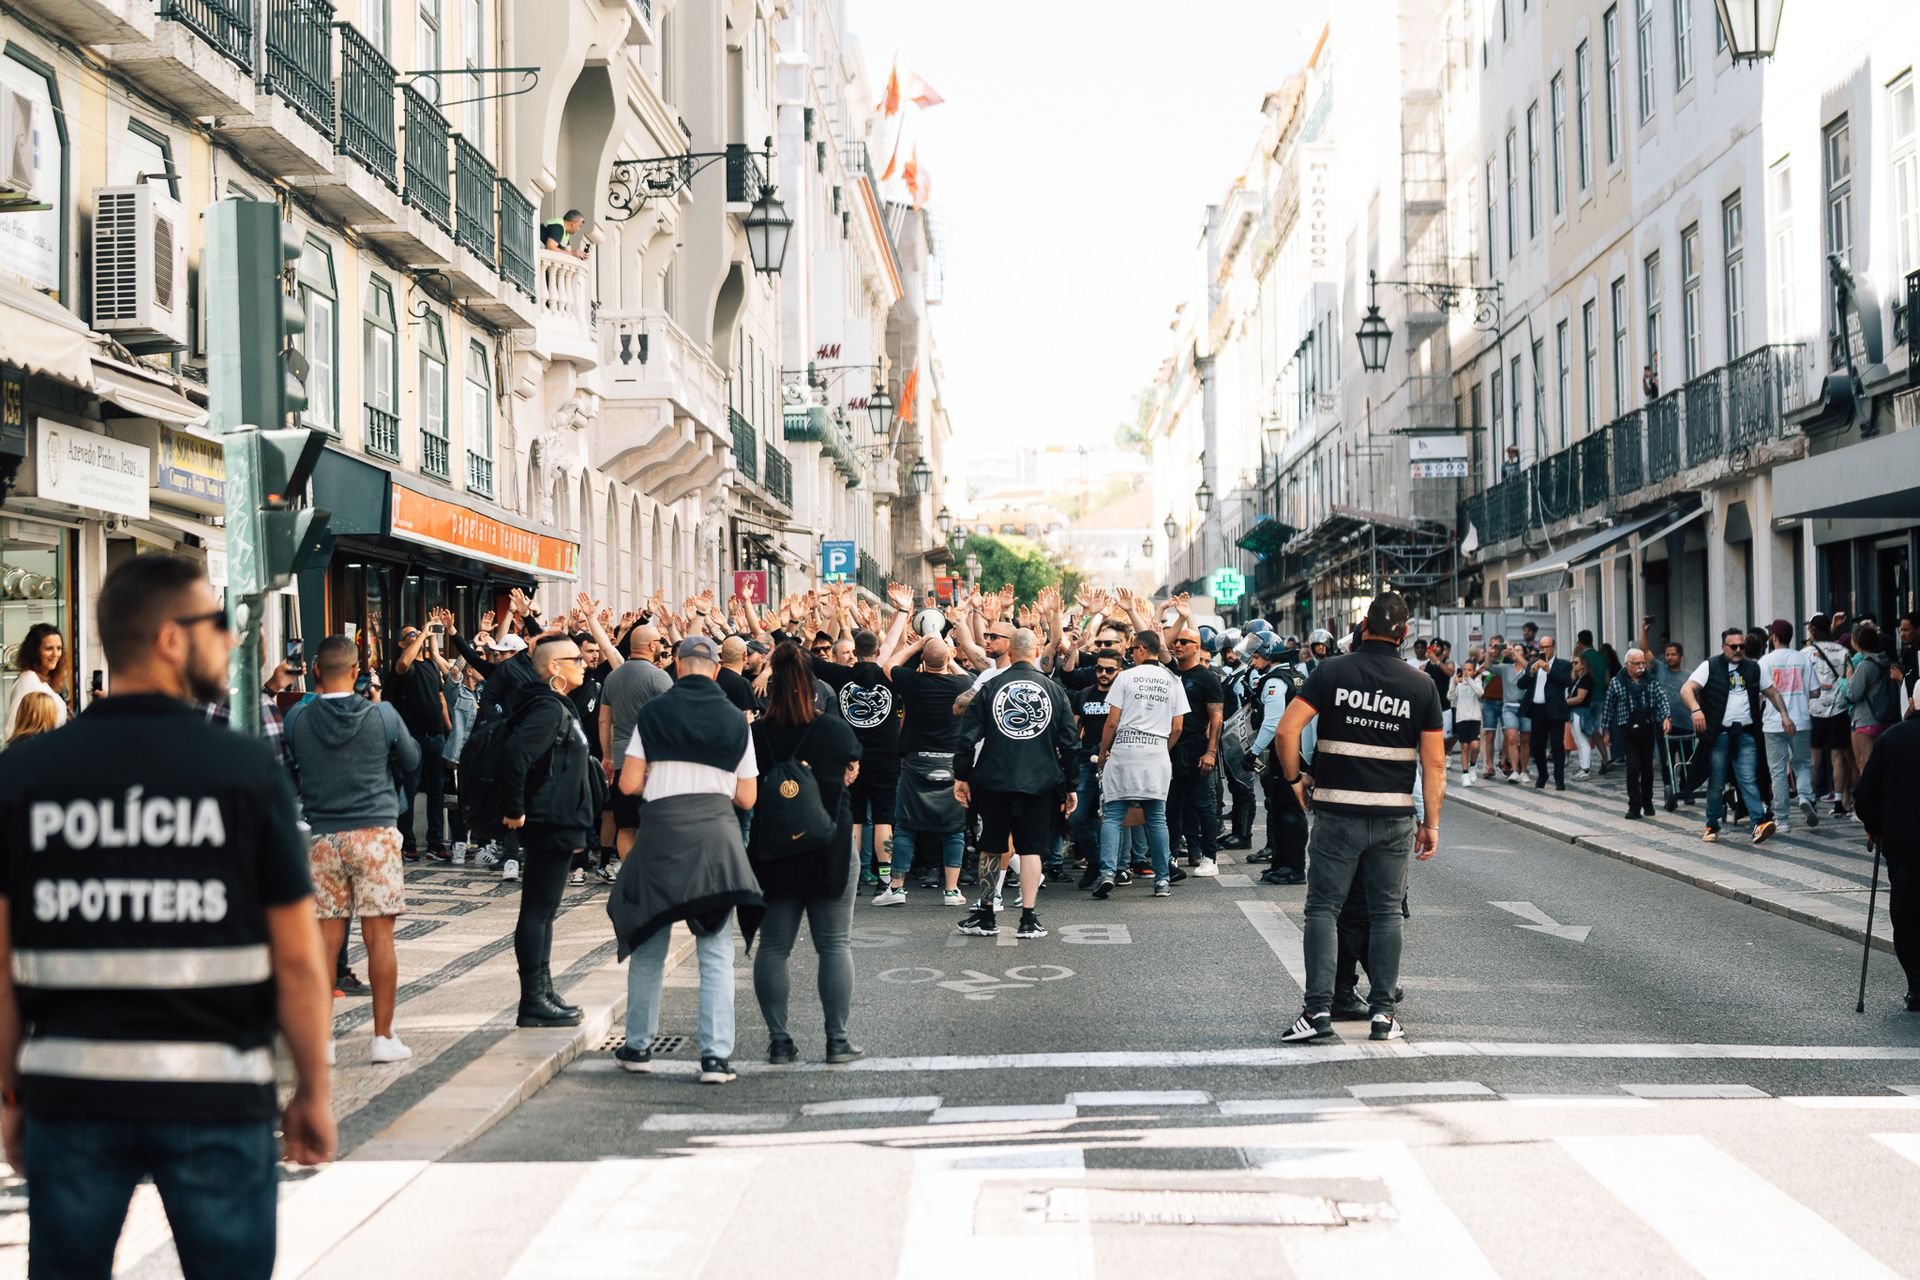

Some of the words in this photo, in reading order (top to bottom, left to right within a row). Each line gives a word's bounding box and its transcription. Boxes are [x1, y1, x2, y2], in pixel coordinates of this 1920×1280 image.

[67, 438, 96, 466] Azevedo
[97, 445, 116, 471] Pinho
[120, 452, 137, 477] Jesus
[451, 513, 497, 545] papelaria
[830, 552, 847, 572] P
[1138, 685, 1168, 694] CONTRO
[1335, 688, 1410, 719] POLÍCIA
[1345, 715, 1400, 732] SPOTTERS
[30, 784, 226, 851] POLÍCIA
[33, 878, 228, 922] SPOTTERS
